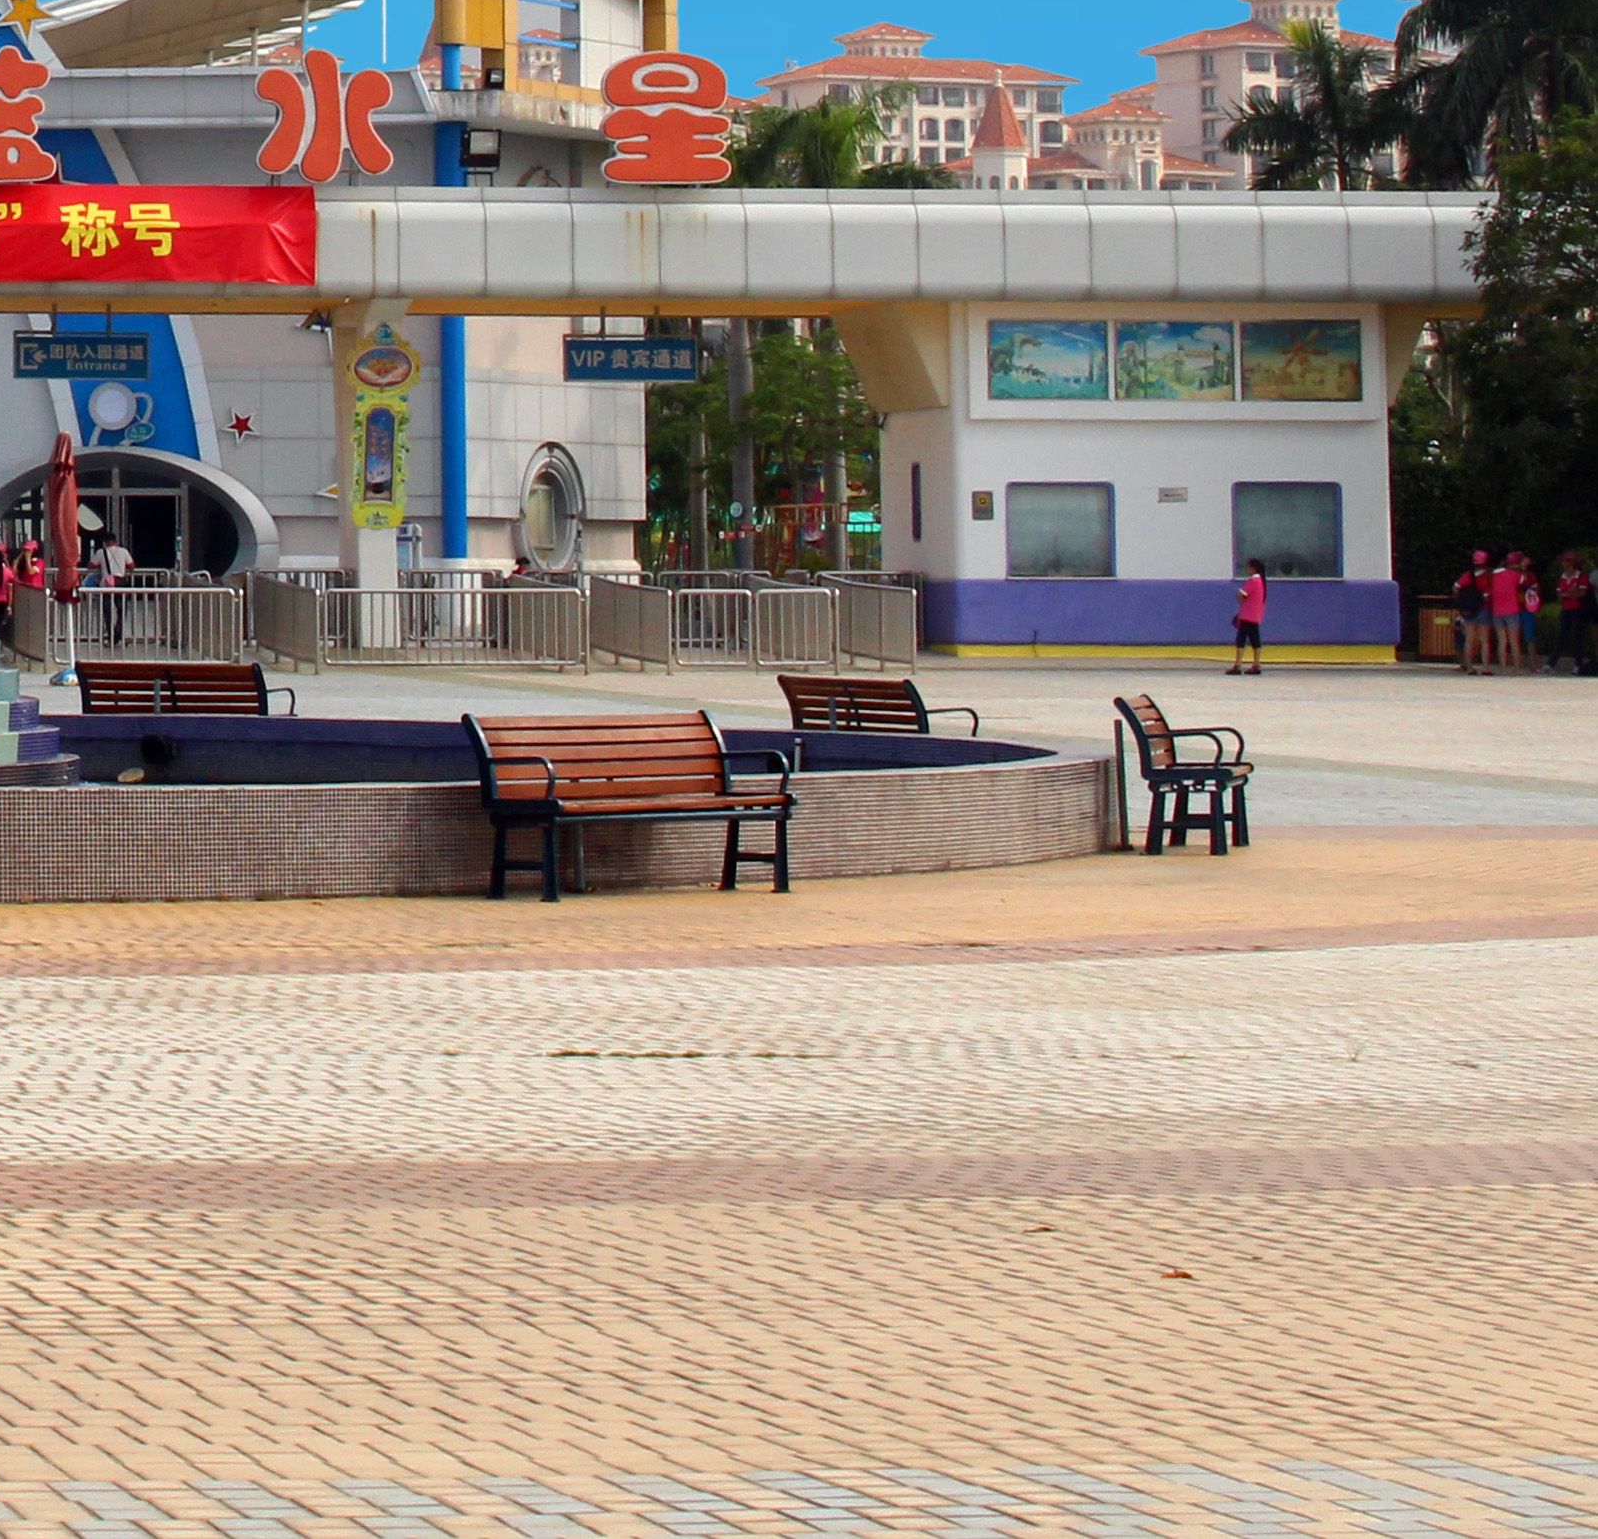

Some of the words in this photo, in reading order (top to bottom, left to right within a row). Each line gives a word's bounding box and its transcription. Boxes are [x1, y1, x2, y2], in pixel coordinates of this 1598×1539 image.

[49, 344, 144, 360] 团队入园通道
[571, 350, 605, 367] VIP
[611, 348, 692, 369] 贵宾通道
[66, 360, 126, 371] Entrance
